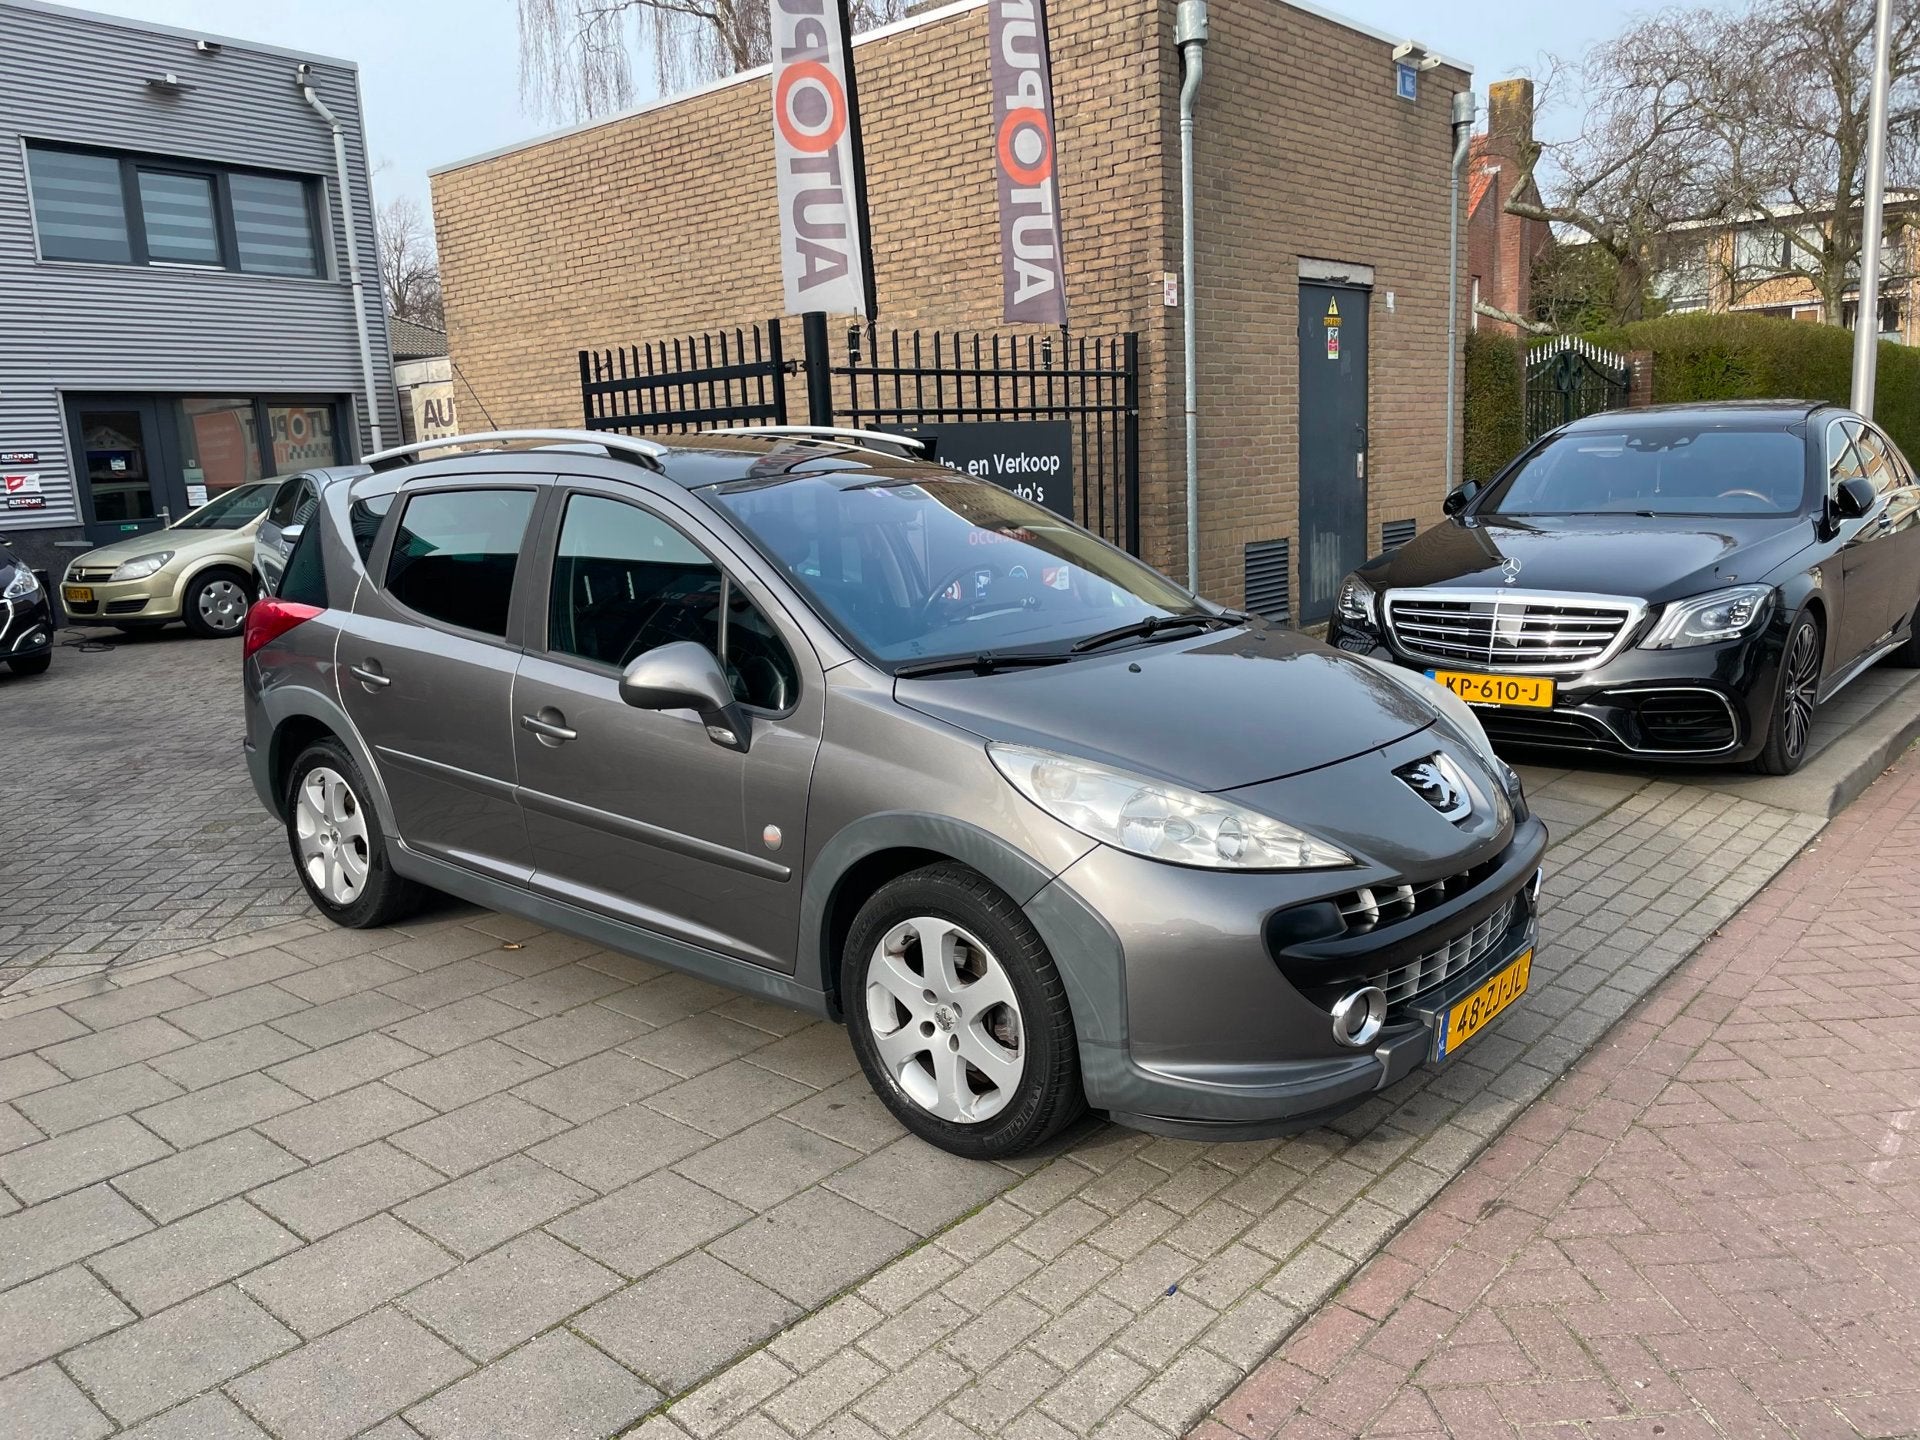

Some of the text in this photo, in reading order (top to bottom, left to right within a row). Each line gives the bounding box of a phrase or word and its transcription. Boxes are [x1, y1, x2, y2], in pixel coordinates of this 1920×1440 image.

[968, 459, 989, 476] en
[993, 452, 1060, 475] Verkoop
[1445, 676, 1540, 702] KP-610-J
[1456, 963, 1522, 1037] 48-ZJ-JL
